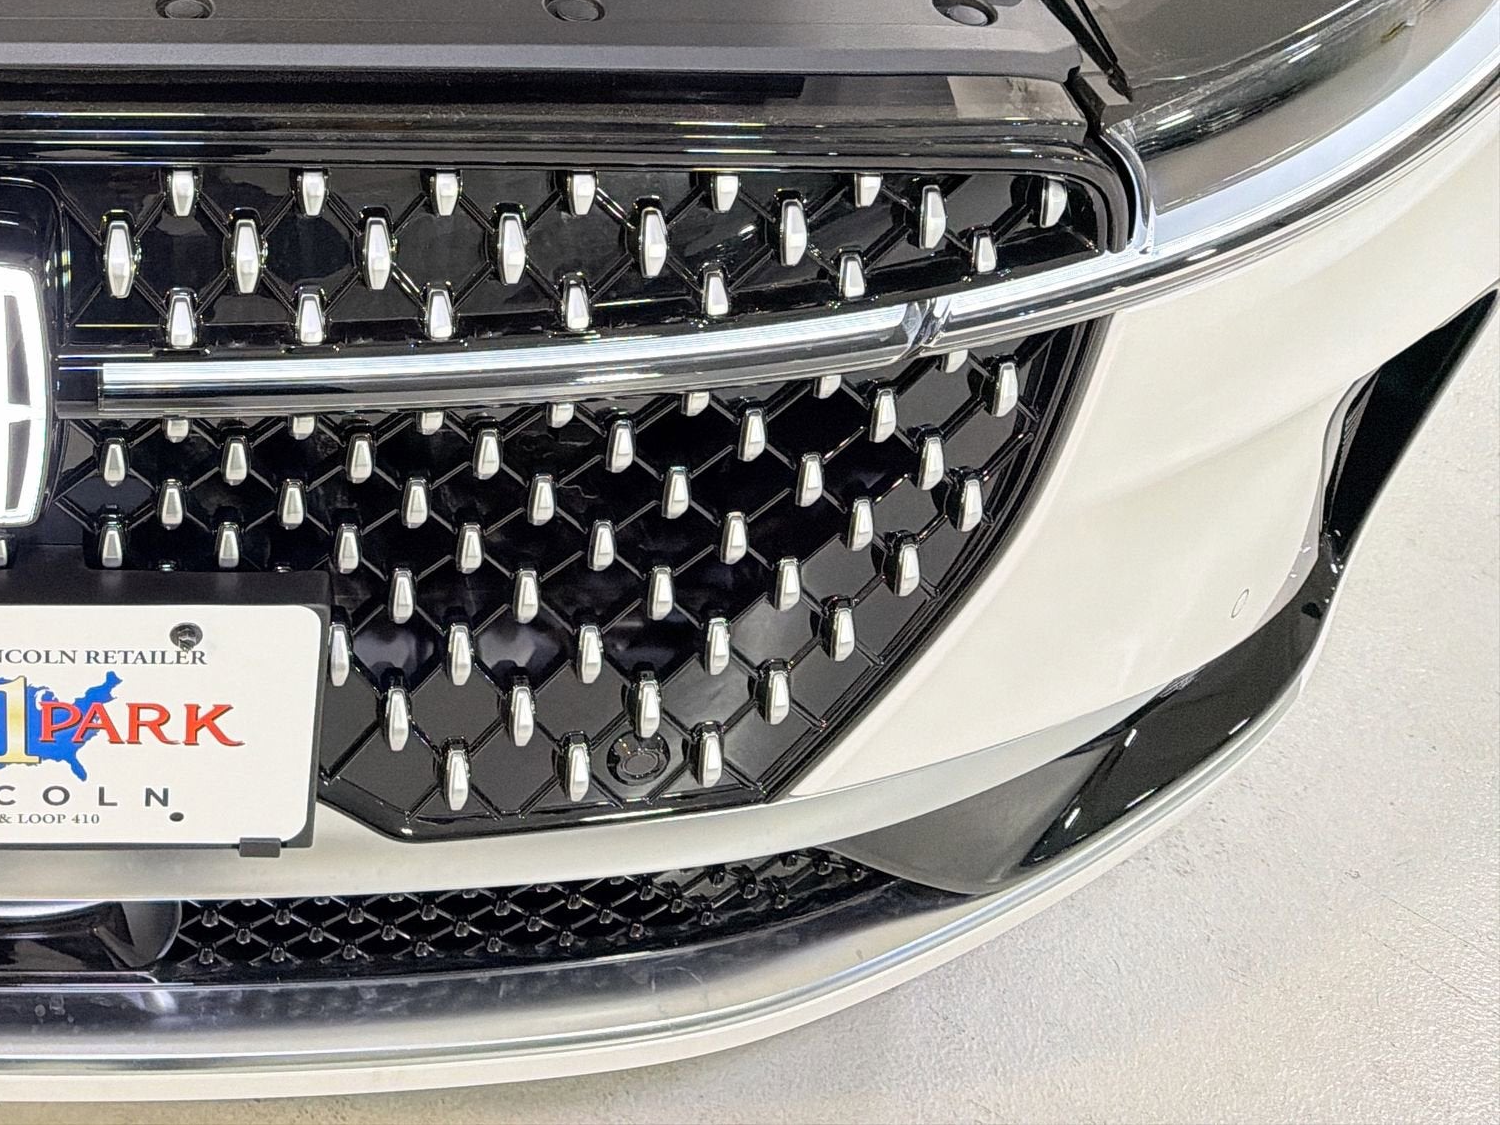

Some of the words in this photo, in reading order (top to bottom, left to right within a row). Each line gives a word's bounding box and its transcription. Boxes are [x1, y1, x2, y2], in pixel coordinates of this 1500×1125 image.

[84, 649, 208, 666] RETAILER
[38, 701, 246, 748] PARK
[18, 813, 67, 824] LOOP
[71, 813, 100, 825] 410
